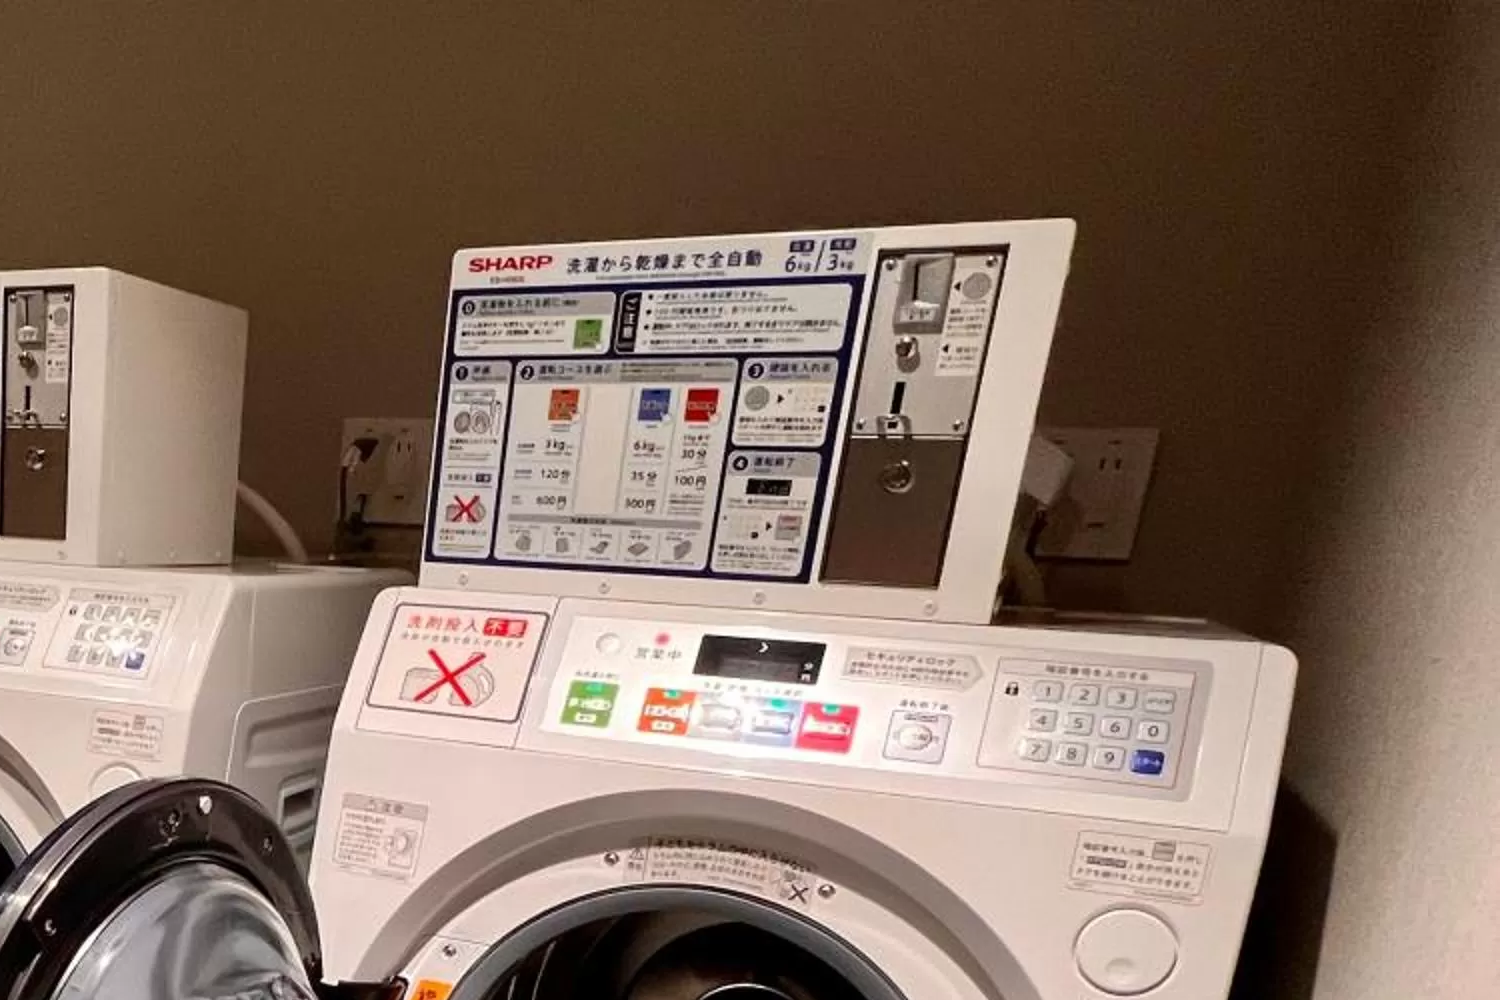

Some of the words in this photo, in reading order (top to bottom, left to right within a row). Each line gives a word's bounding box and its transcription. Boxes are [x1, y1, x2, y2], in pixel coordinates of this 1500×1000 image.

[468, 255, 553, 272] SHARP
[566, 250, 762, 273] 洗濯から乾燥まで全自動
[406, 614, 479, 633] 洗剤投入
[1045, 686, 1051, 697] 1
[1079, 688, 1091, 701] 2
[1116, 691, 1127, 704] 3
[1036, 715, 1047, 726] 4
[1074, 717, 1084, 729] 5
[1109, 720, 1121, 734] 6
[1147, 725, 1159, 737] 0
[1031, 743, 1042, 756] 7
[1066, 747, 1077, 761] 8
[1104, 751, 1115, 764] 9
